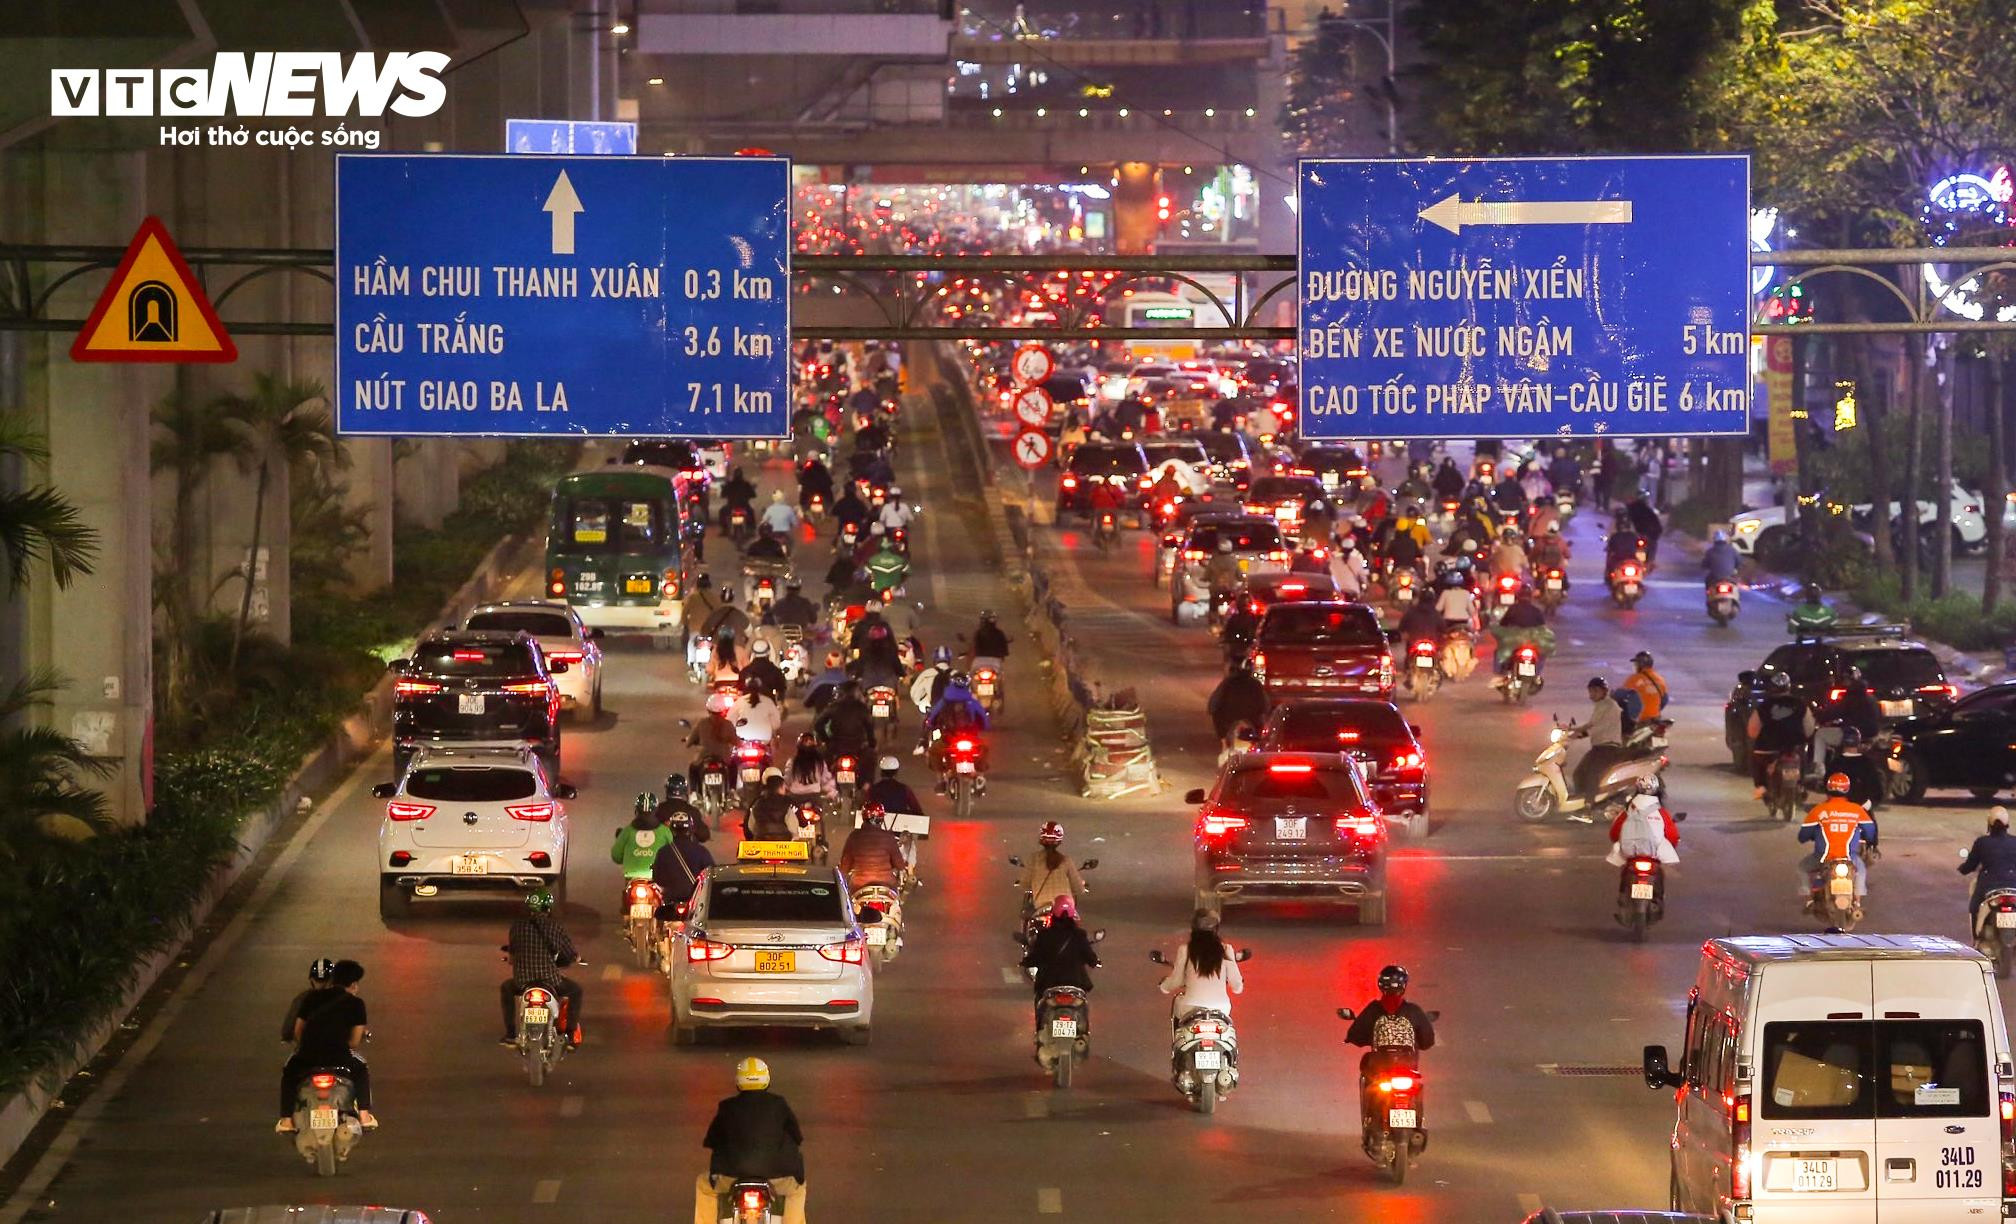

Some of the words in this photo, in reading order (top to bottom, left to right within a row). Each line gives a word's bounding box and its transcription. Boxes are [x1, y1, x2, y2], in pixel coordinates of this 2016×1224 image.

[354, 255, 410, 297] HẦM
[422, 267, 481, 297] CHUI
[493, 266, 578, 298] THANH
[591, 262, 660, 298] XUÂN
[684, 269, 721, 301] 0,3
[733, 269, 772, 299] km
[1308, 261, 1397, 301] ĐƯỜNG
[1410, 258, 1511, 301] NGUYỄN
[1525, 255, 1583, 299] XIỂN
[355, 312, 404, 354] CẦU
[417, 311, 504, 354] TRẮNG
[684, 326, 721, 358] 3,6
[733, 327, 772, 357] km
[1309, 311, 1361, 358] BẾN
[1372, 328, 1404, 358] XE
[1416, 319, 1486, 358] NƯỚC
[1498, 315, 1573, 357] NGẦM
[1682, 325, 1698, 355] 5
[1706, 325, 1745, 355] km
[355, 372, 406, 411] NÚT
[419, 381, 478, 411] GIAO
[490, 381, 524, 412] BA
[537, 382, 569, 412] LA
[687, 383, 721, 415] 7,1
[734, 383, 772, 413] km
[1309, 384, 1358, 416] CAO
[1368, 373, 1417, 415] TỐC
[1426, 375, 1491, 414] PHÁP
[1627, 375, 1668, 412] GIẼ
[1679, 381, 1693, 412] 6
[1706, 381, 1745, 412] km
[633, 848, 654, 857] Grab
[766, 952, 784, 961] 30F
[1802, 1160, 1828, 1174] 34LD
[1941, 1146, 1975, 1166] 34LD
[1936, 1169, 1983, 1188] 011.29
